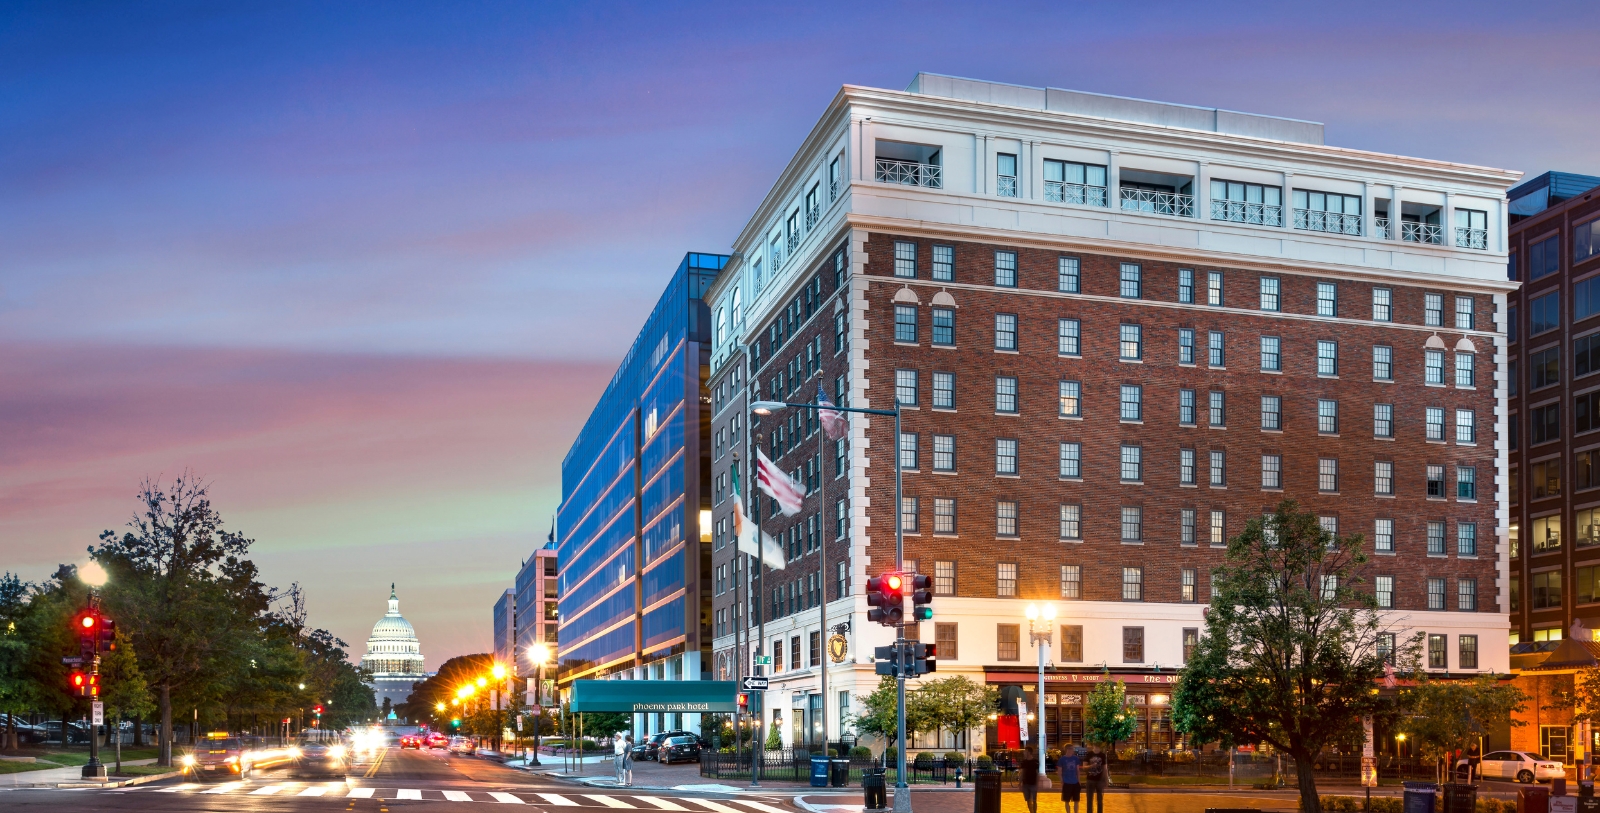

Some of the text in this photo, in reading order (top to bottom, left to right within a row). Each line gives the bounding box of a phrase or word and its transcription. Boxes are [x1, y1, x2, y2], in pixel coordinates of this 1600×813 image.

[633, 702, 709, 711] phoenix park hotel
